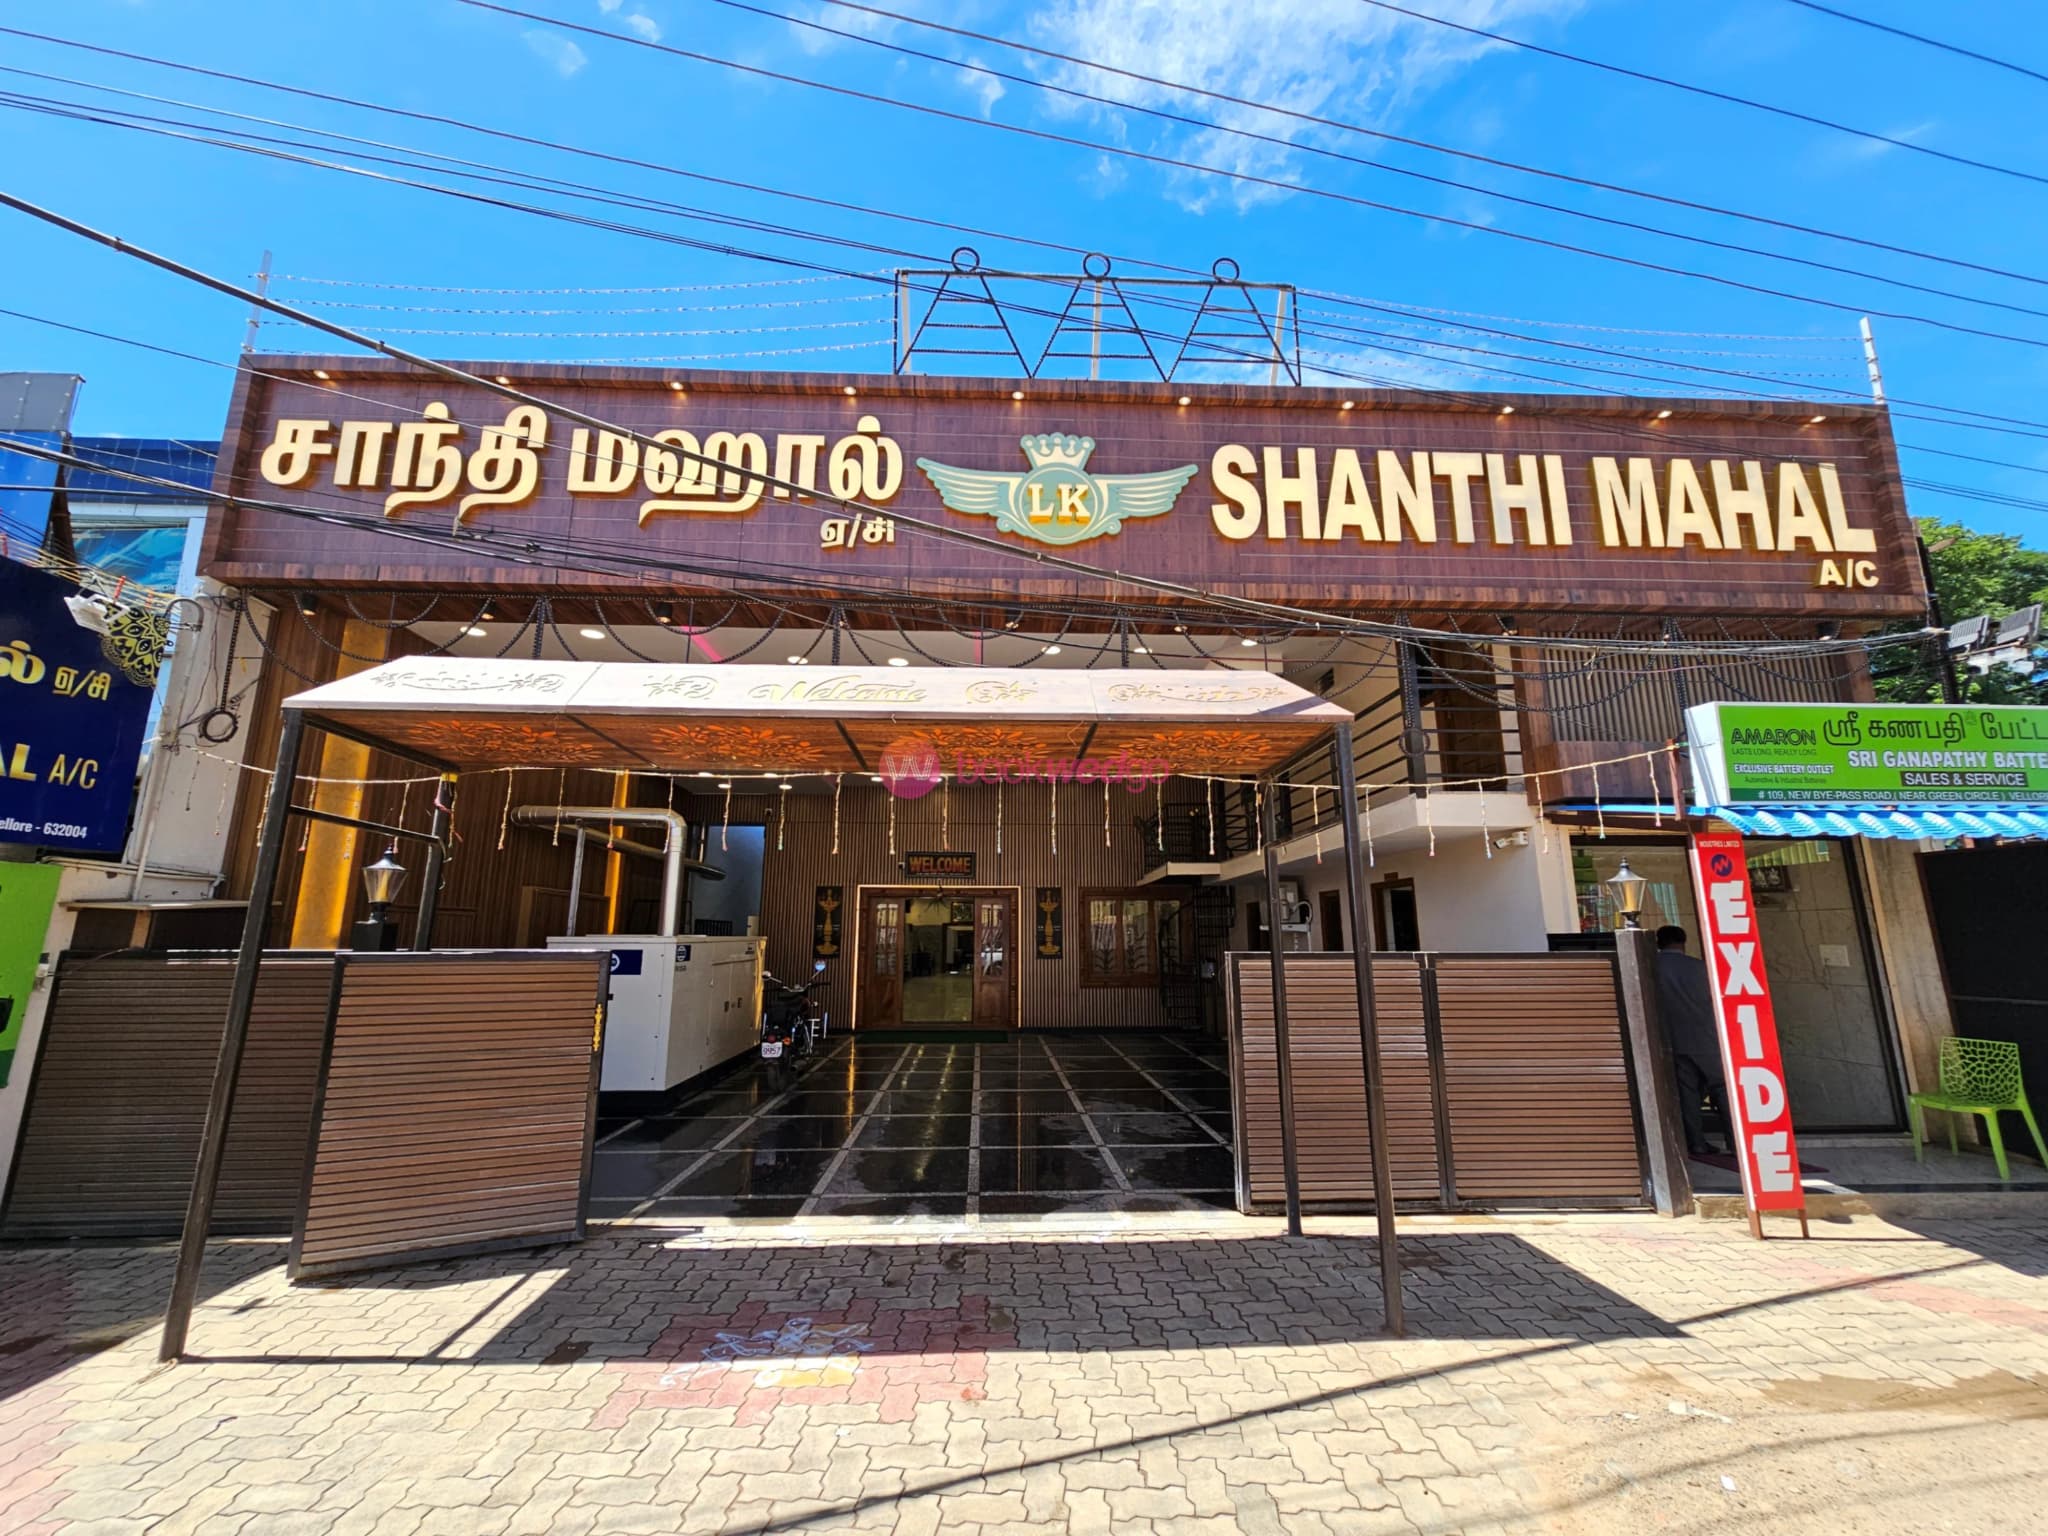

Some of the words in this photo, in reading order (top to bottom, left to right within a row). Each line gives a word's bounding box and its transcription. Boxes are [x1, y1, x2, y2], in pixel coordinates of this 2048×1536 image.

[260, 401, 547, 520] சாந்தி
[567, 415, 903, 527] மஹால்
[1028, 483, 1090, 524] LK
[1211, 444, 1573, 546] SHANTHI
[1592, 456, 1877, 552] MAHAL
[1818, 559, 1879, 588] A/C
[1731, 727, 1816, 746] AMARON
[1868, 712, 1966, 748] கணபதி
[48, 753, 98, 789] A/C
[1734, 763, 1774, 774] EXCLUSIVE
[1775, 764, 1805, 774] BATTERY
[1807, 764, 1834, 775] OUTLET
[1847, 750, 1878, 767] SRI
[1883, 751, 1987, 768] GANAPATHY
[1905, 772, 1950, 786] SALES
[1953, 773, 1962, 786] &
[1965, 773, 2025, 787] SERVICE
[1759, 791, 1765, 800] #
[1767, 791, 1786, 801] 109,
[1788, 791, 1811, 800] NEW
[1813, 791, 1862, 800] BYE-PASS
[1899, 791, 1927, 800] NEAR
[1928, 791, 1962, 800] GREEN
[1964, 791, 1999, 800] CIRCLE
[43, 822, 88, 839] 632004
[909, 856, 971, 873] WELCOME
[1710, 880, 1794, 1192] EXIDE
